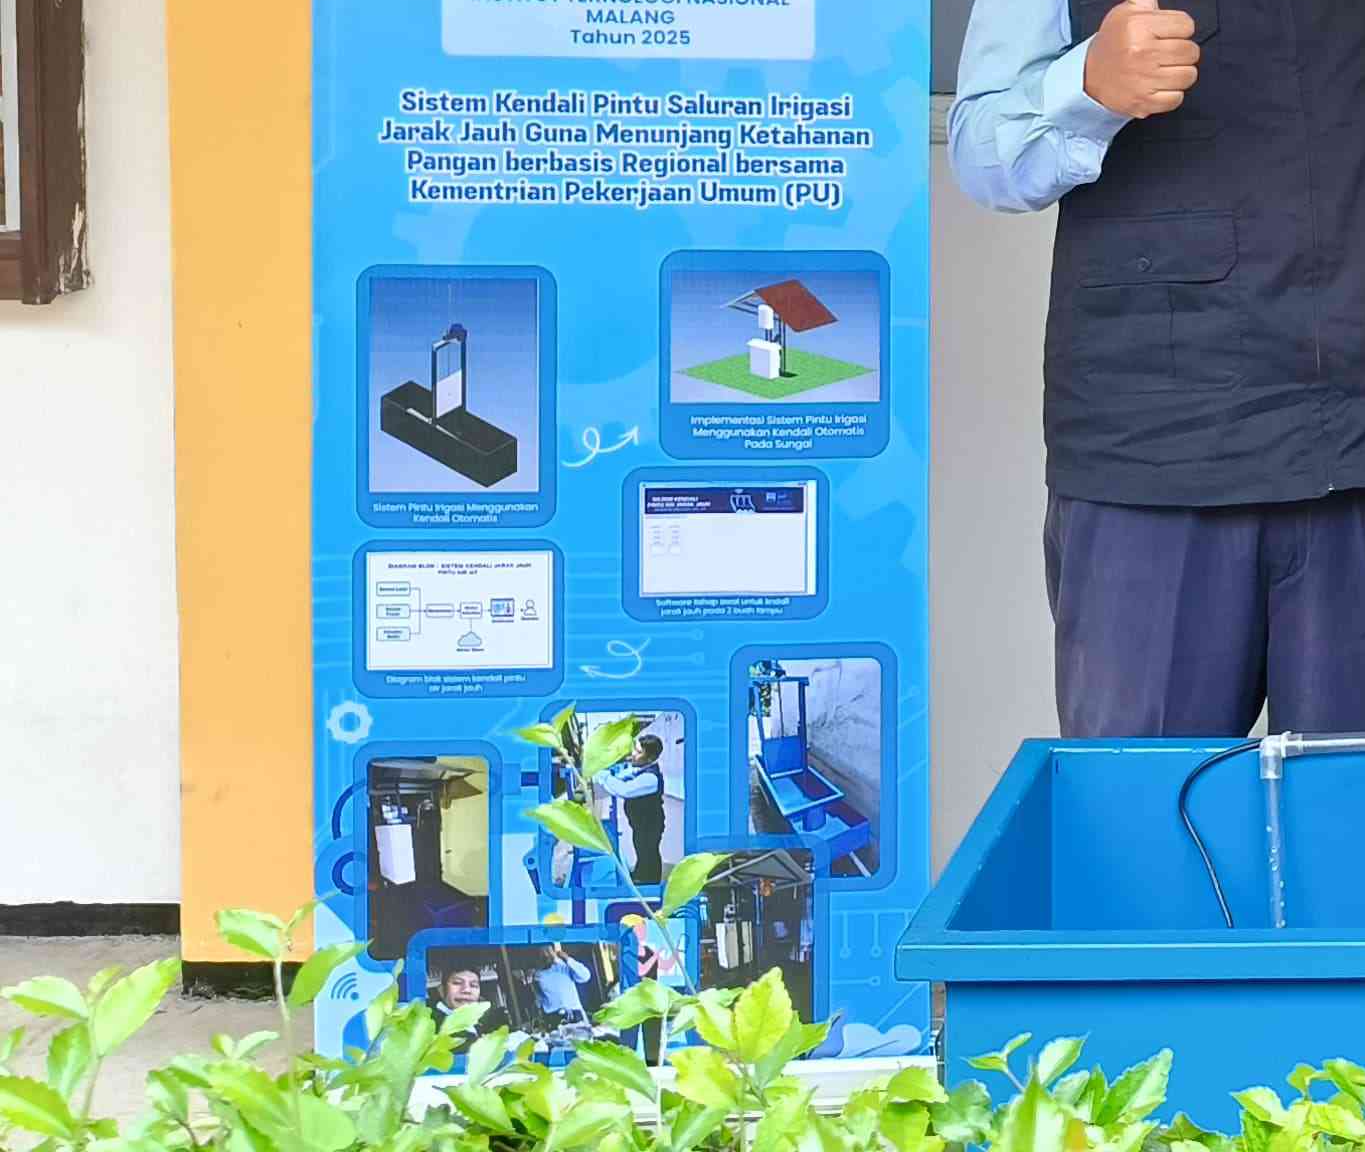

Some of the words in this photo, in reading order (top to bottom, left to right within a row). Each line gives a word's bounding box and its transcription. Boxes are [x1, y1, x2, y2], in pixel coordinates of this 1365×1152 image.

[586, 9, 675, 24] MALANG
[571, 29, 635, 45] Tahun
[642, 30, 690, 45] 2025
[401, 92, 487, 113] Sistem
[495, 94, 585, 115] Kendali
[593, 94, 658, 115] Pintu
[668, 95, 762, 116] Saluran
[771, 96, 851, 121] Irigasi
[381, 121, 450, 143] Jarak
[460, 122, 516, 144] Jauh
[525, 124, 587, 144] Guna
[597, 124, 731, 149] Menunjang
[740, 125, 870, 146] Ketahanan
[407, 152, 496, 176] Pangan
[506, 152, 613, 173] berbasis
[622, 153, 727, 177] Regional
[736, 154, 844, 175] bersama
[411, 181, 555, 202] Kementrian
[565, 182, 691, 208] Pekerjaan
[701, 183, 776, 204] Umum
[785, 183, 841, 207] (PU)
